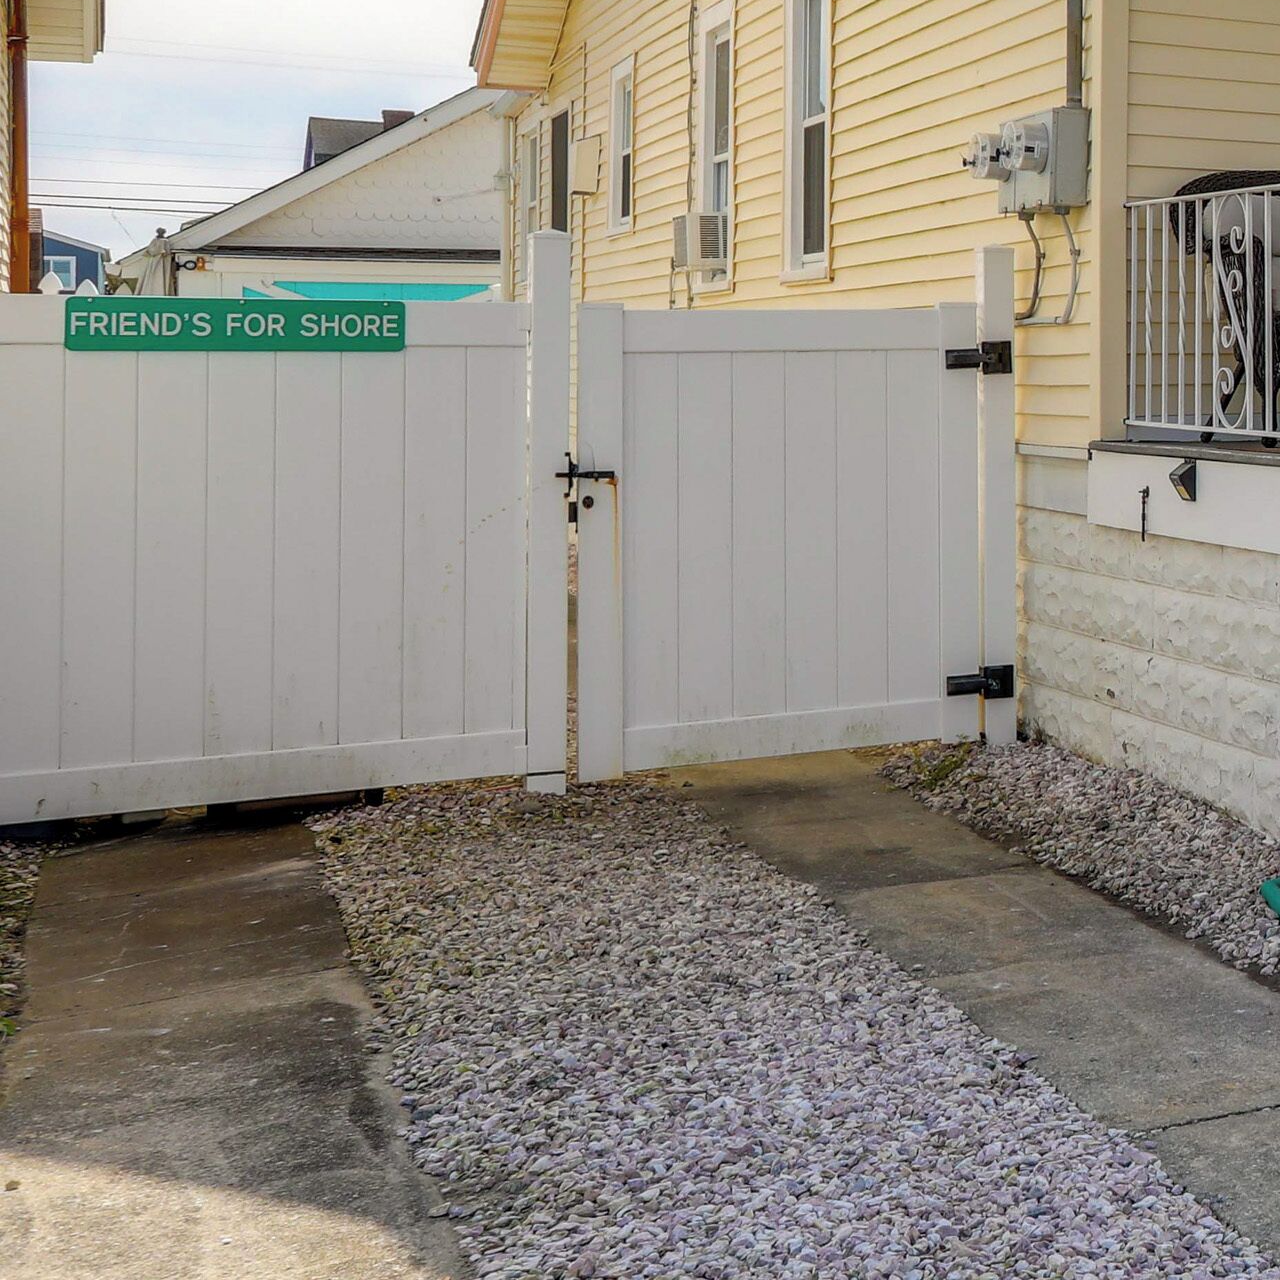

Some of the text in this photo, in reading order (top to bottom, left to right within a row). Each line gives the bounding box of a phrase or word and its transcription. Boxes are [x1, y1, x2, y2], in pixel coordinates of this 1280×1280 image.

[70, 312, 399, 337] FRIEND'S FOR SHORE
